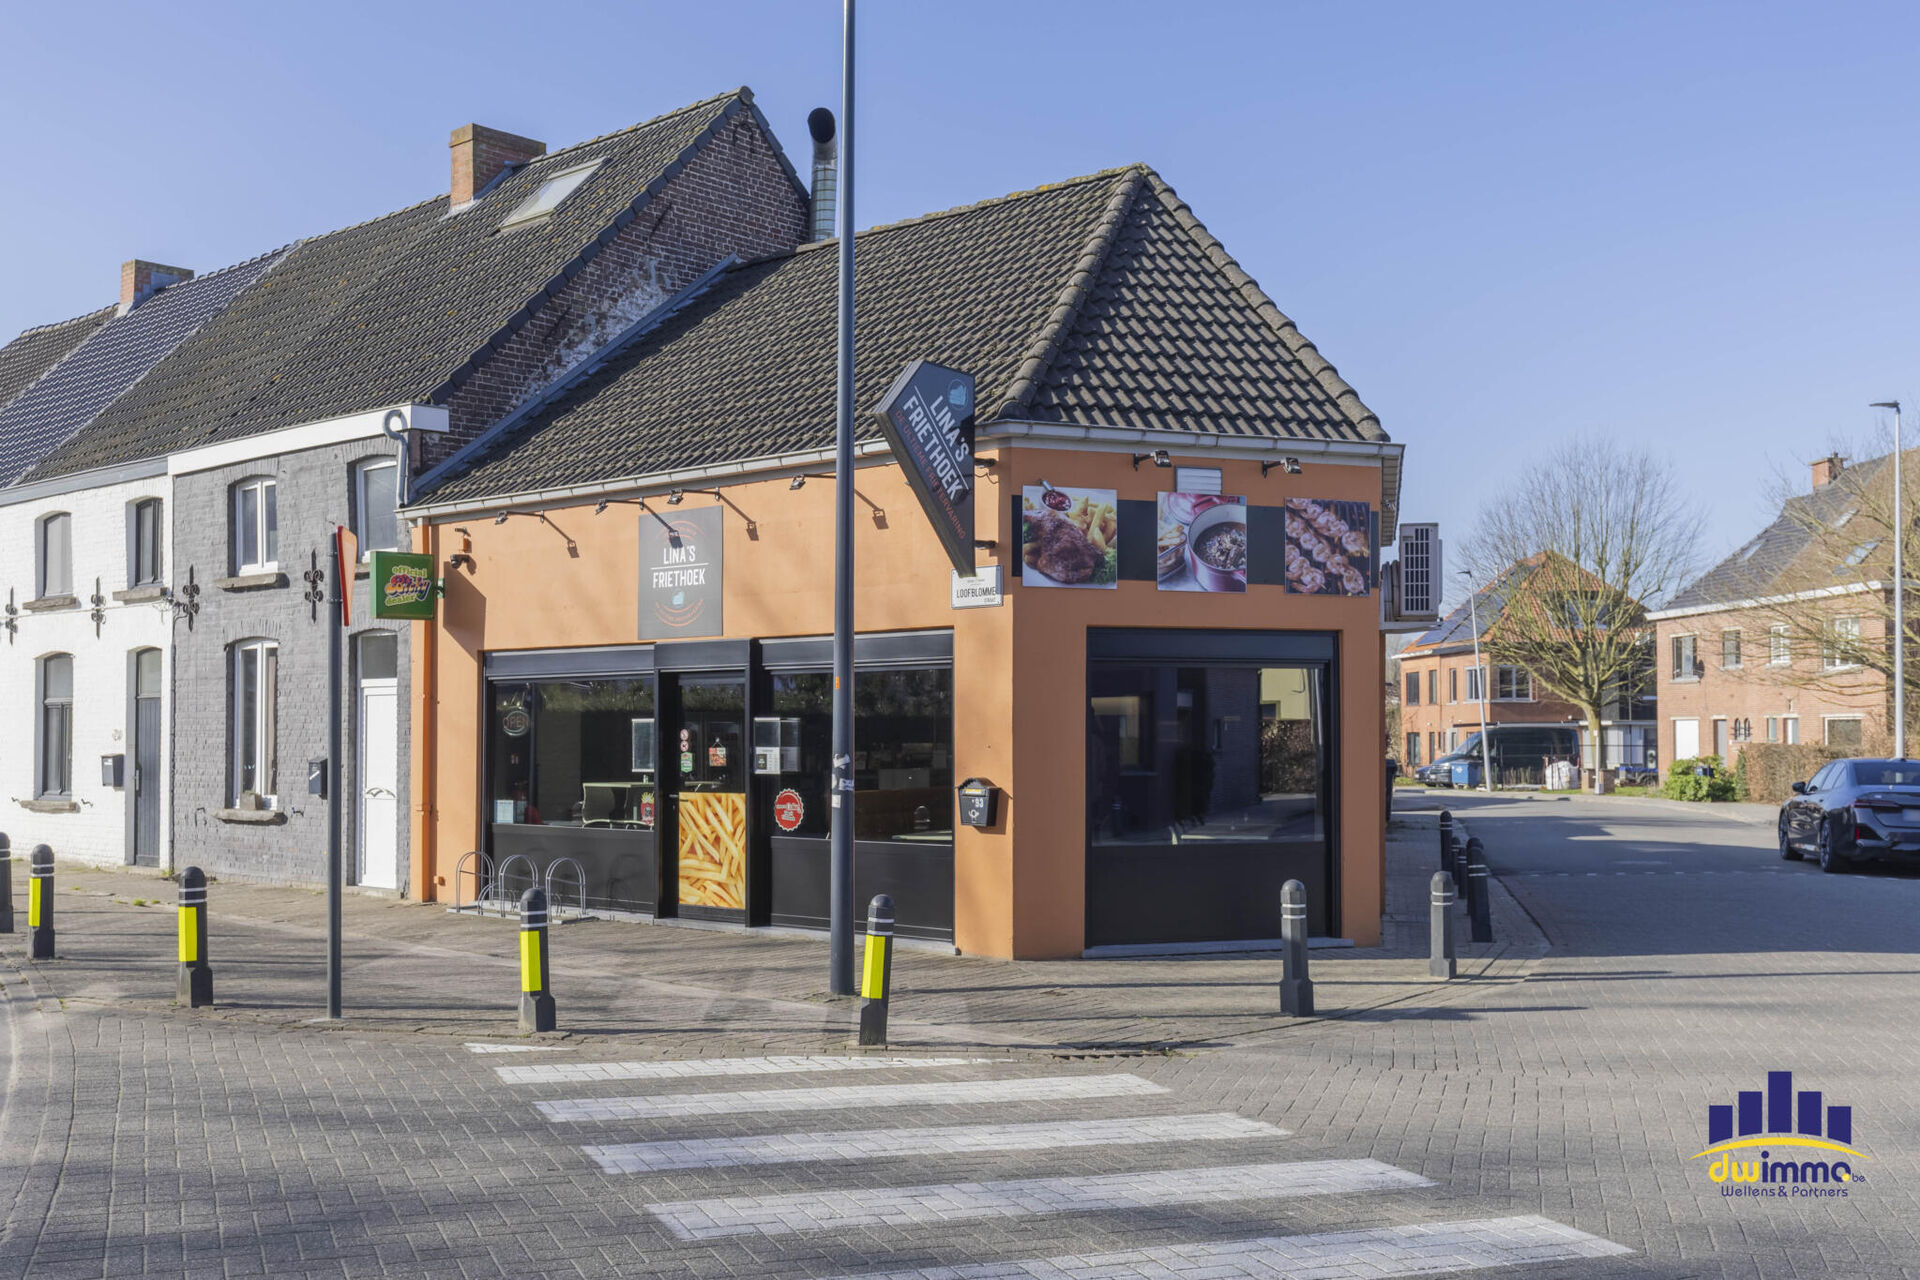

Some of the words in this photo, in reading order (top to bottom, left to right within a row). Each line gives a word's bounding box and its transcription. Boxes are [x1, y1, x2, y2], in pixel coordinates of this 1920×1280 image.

[930, 395, 969, 462] LINA'S
[903, 425, 928, 466] ULTIEME
[903, 395, 963, 500] FRIETHOEK
[663, 545, 696, 564] LINA'S
[652, 568, 706, 589] FRIETHOEK
[956, 586, 996, 599] LOOFBLOMME
